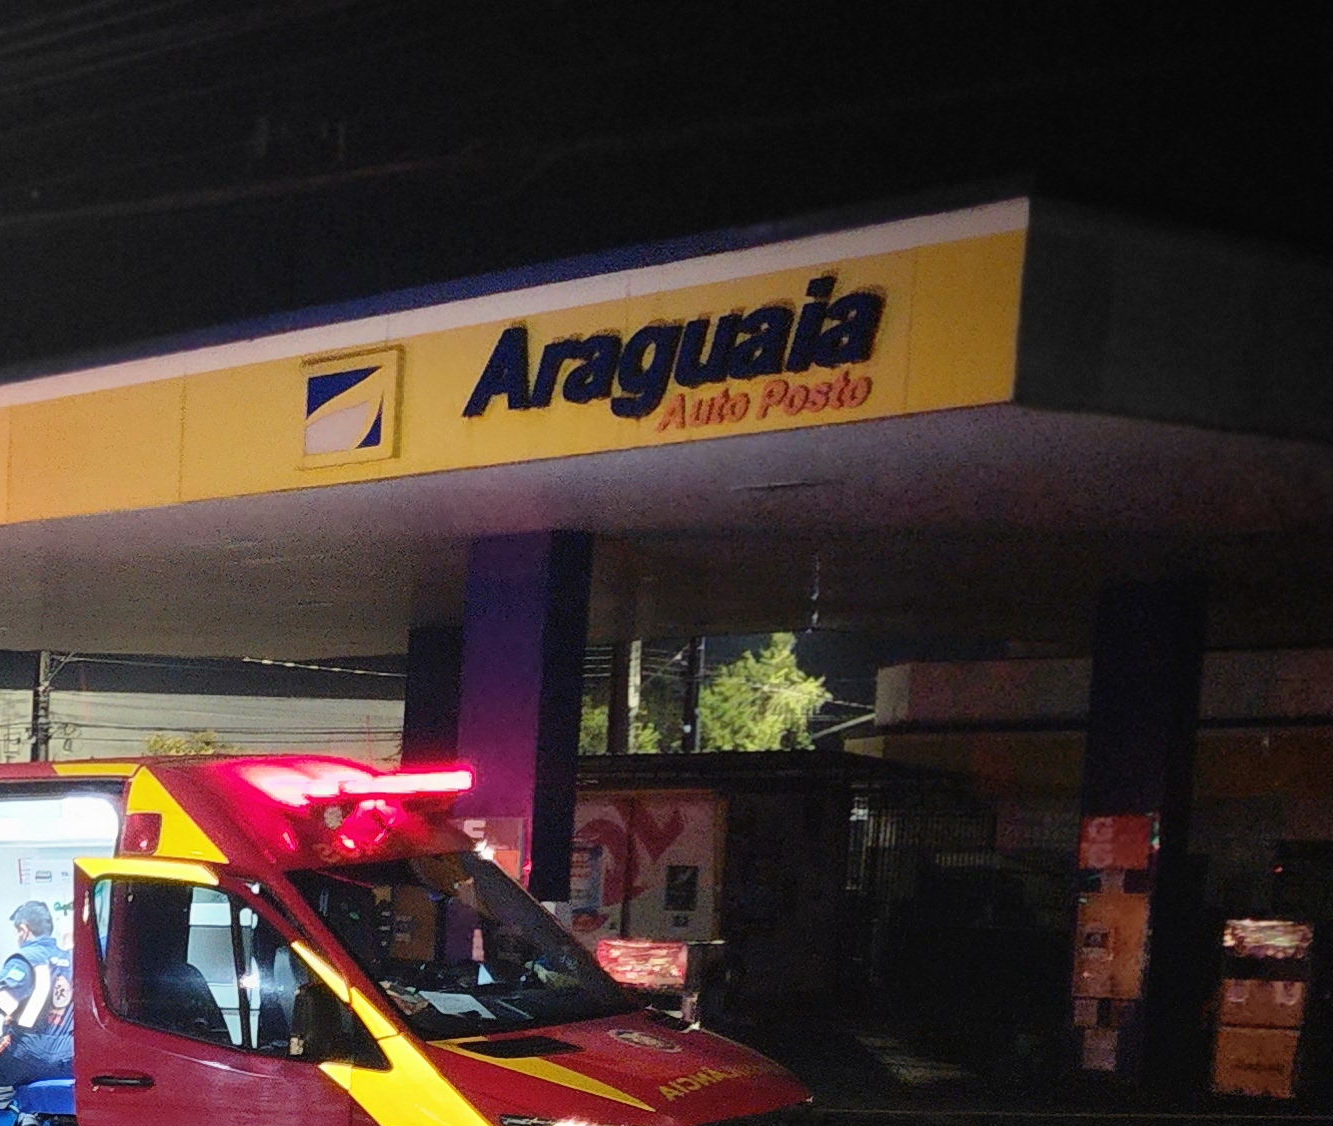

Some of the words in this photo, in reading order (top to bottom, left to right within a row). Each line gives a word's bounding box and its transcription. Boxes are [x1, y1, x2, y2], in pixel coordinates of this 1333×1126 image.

[462, 272, 889, 420] Araguaia
[657, 394, 751, 433] Auto
[757, 368, 875, 421] Posto
